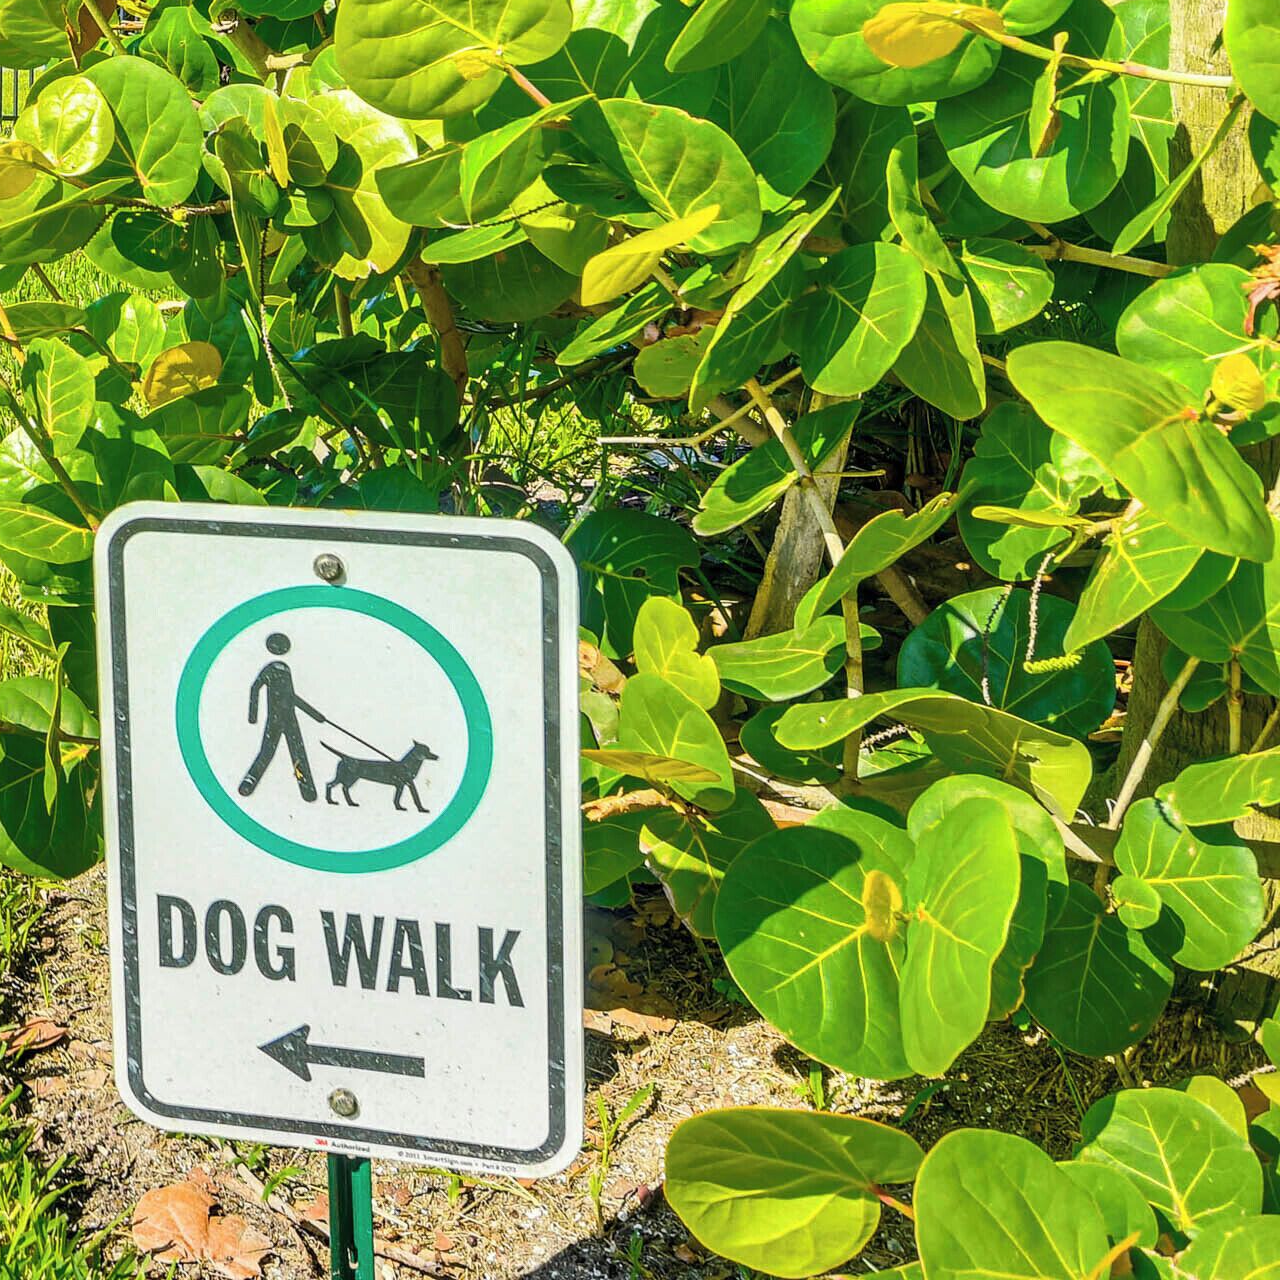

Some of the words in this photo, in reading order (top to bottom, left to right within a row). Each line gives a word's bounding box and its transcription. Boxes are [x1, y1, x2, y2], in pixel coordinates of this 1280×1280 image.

[156, 894, 296, 982] DOG
[320, 909, 525, 1008] WALK
[332, 1141, 370, 1152] Authorized
